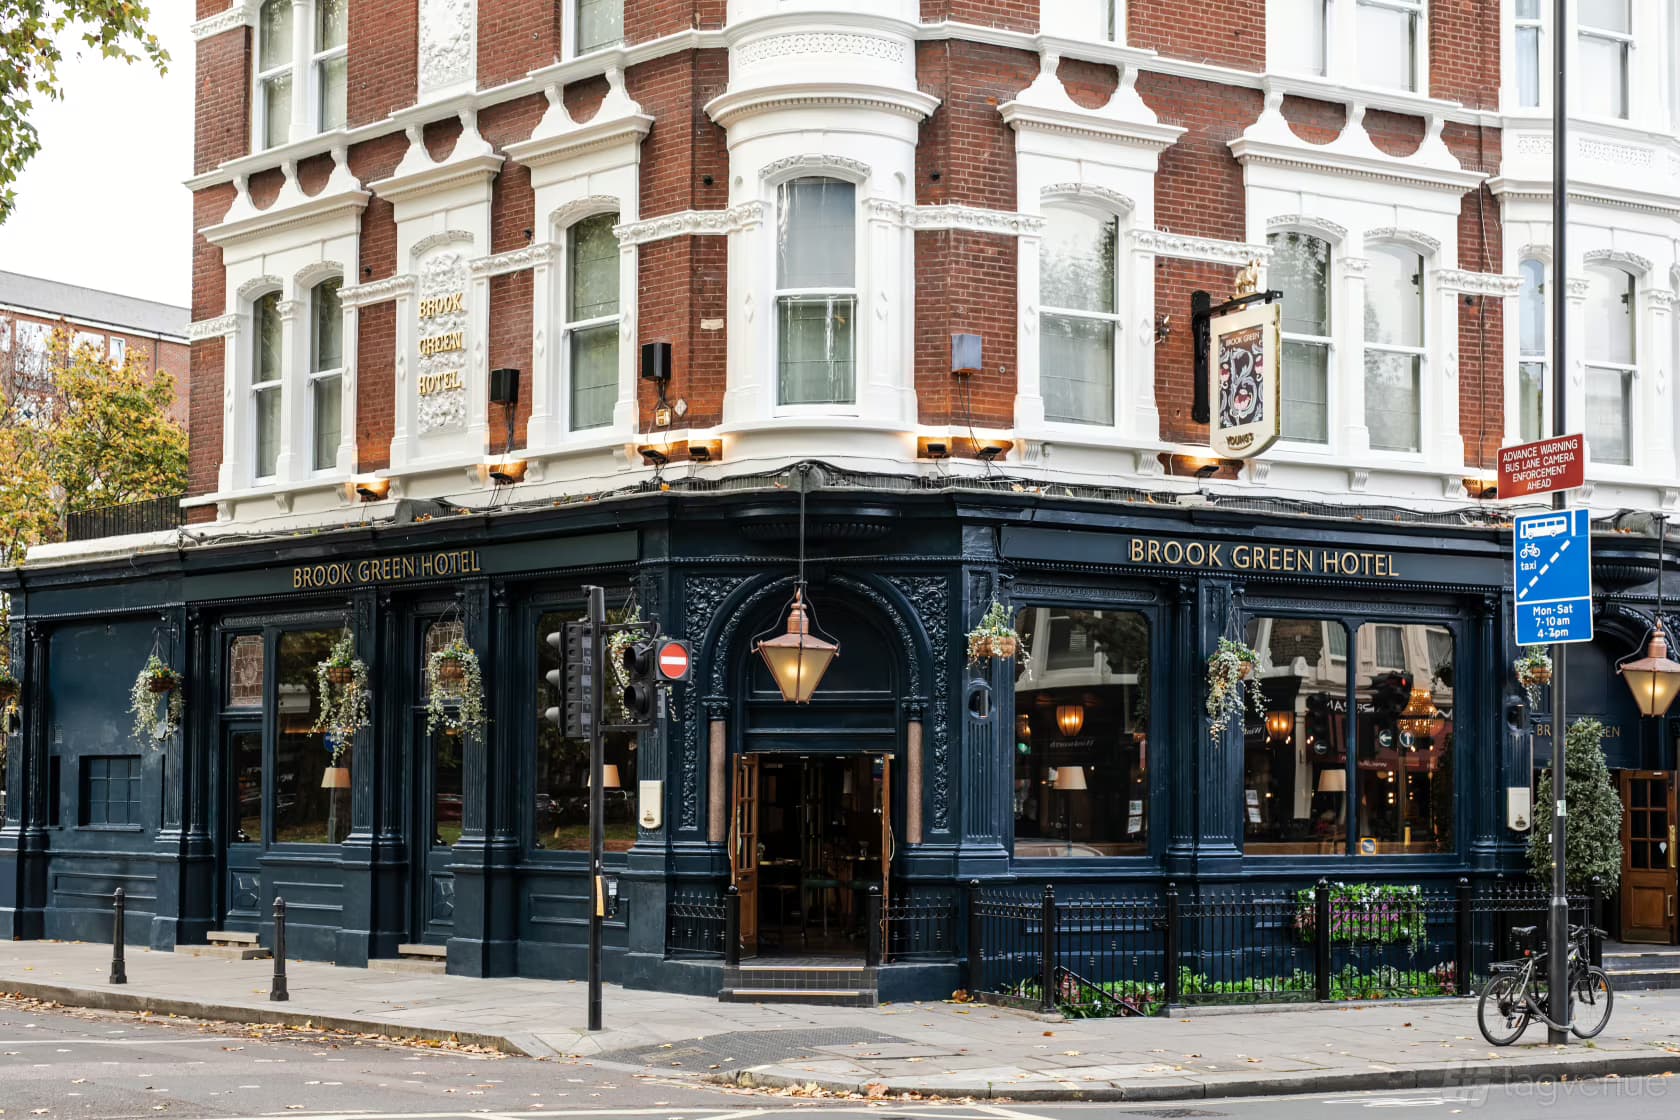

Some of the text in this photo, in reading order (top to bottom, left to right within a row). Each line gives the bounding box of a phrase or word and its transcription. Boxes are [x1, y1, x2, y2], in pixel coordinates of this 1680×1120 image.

[419, 293, 463, 319] BROOK
[419, 332, 464, 358] GREEN
[418, 371, 463, 397] HOTEL
[1503, 439, 1578, 462] ADVANCE WARNING
[1505, 452, 1575, 473] BUS LANE CAMERA
[1512, 465, 1567, 483] ENFORCEMENT
[1527, 478, 1552, 491] AHEAD
[293, 550, 481, 588] BROOK GREEN HOTEL
[1130, 538, 1400, 577] BROOK GREEN HOTEL
[1520, 560, 1537, 571] taxi
